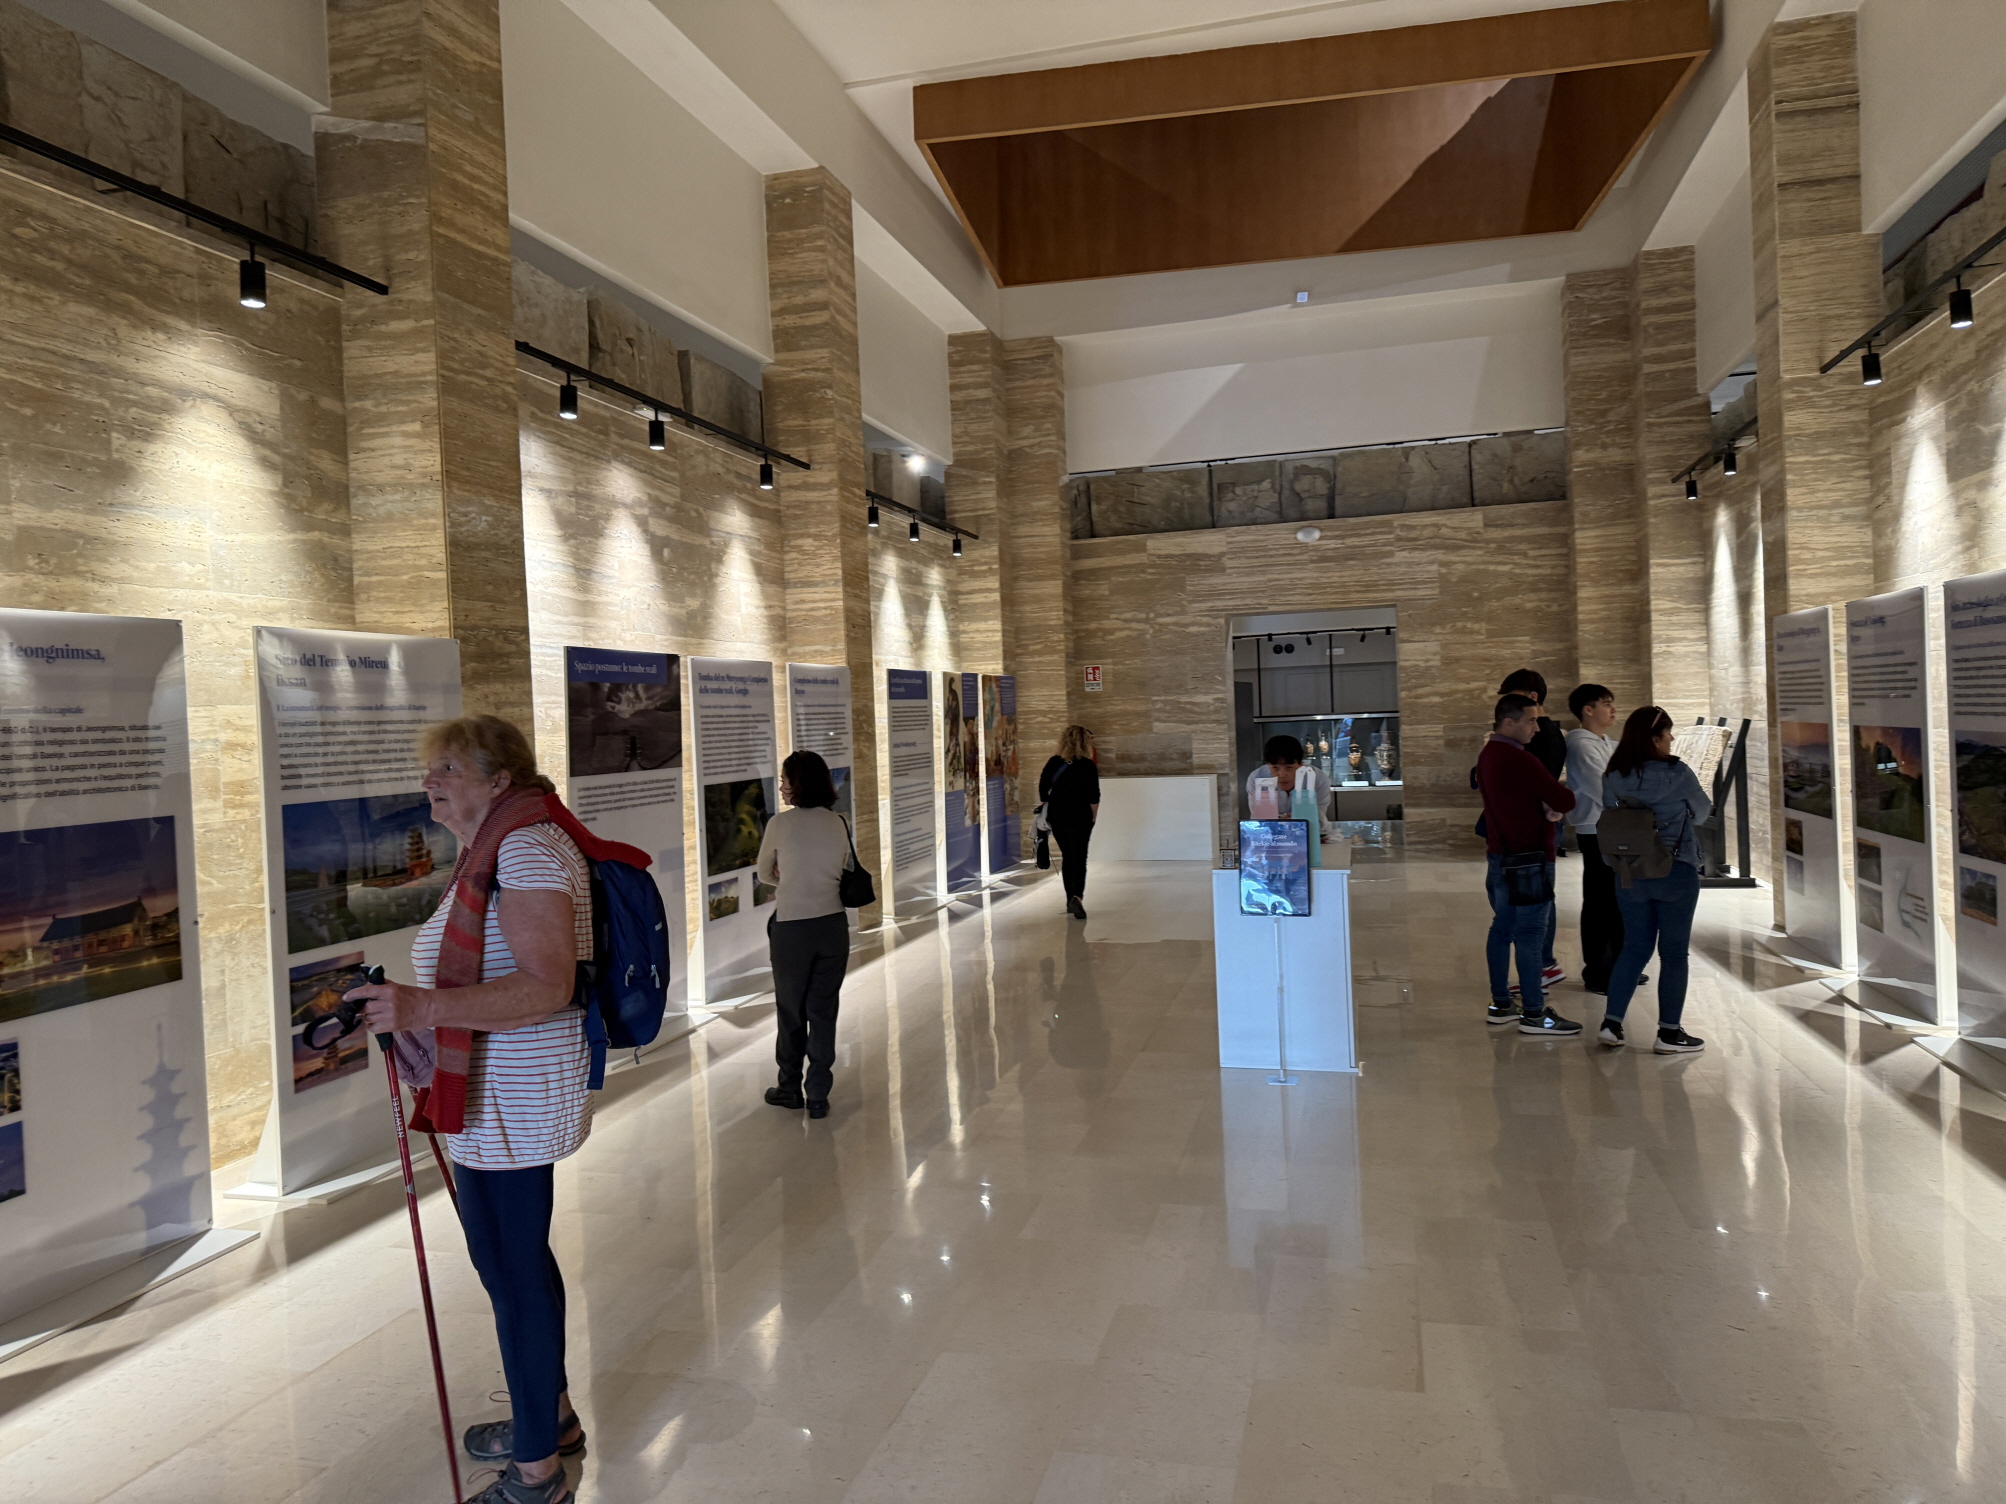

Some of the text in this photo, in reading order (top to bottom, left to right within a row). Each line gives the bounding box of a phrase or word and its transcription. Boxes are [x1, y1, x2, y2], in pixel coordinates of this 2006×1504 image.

[300, 653, 317, 667] del
[574, 660, 595, 673] Spazio
[622, 662, 628, 672] le
[629, 663, 645, 673] tombe
[645, 664, 658, 674] reali
[393, 1095, 405, 1138] NEWFEEL
